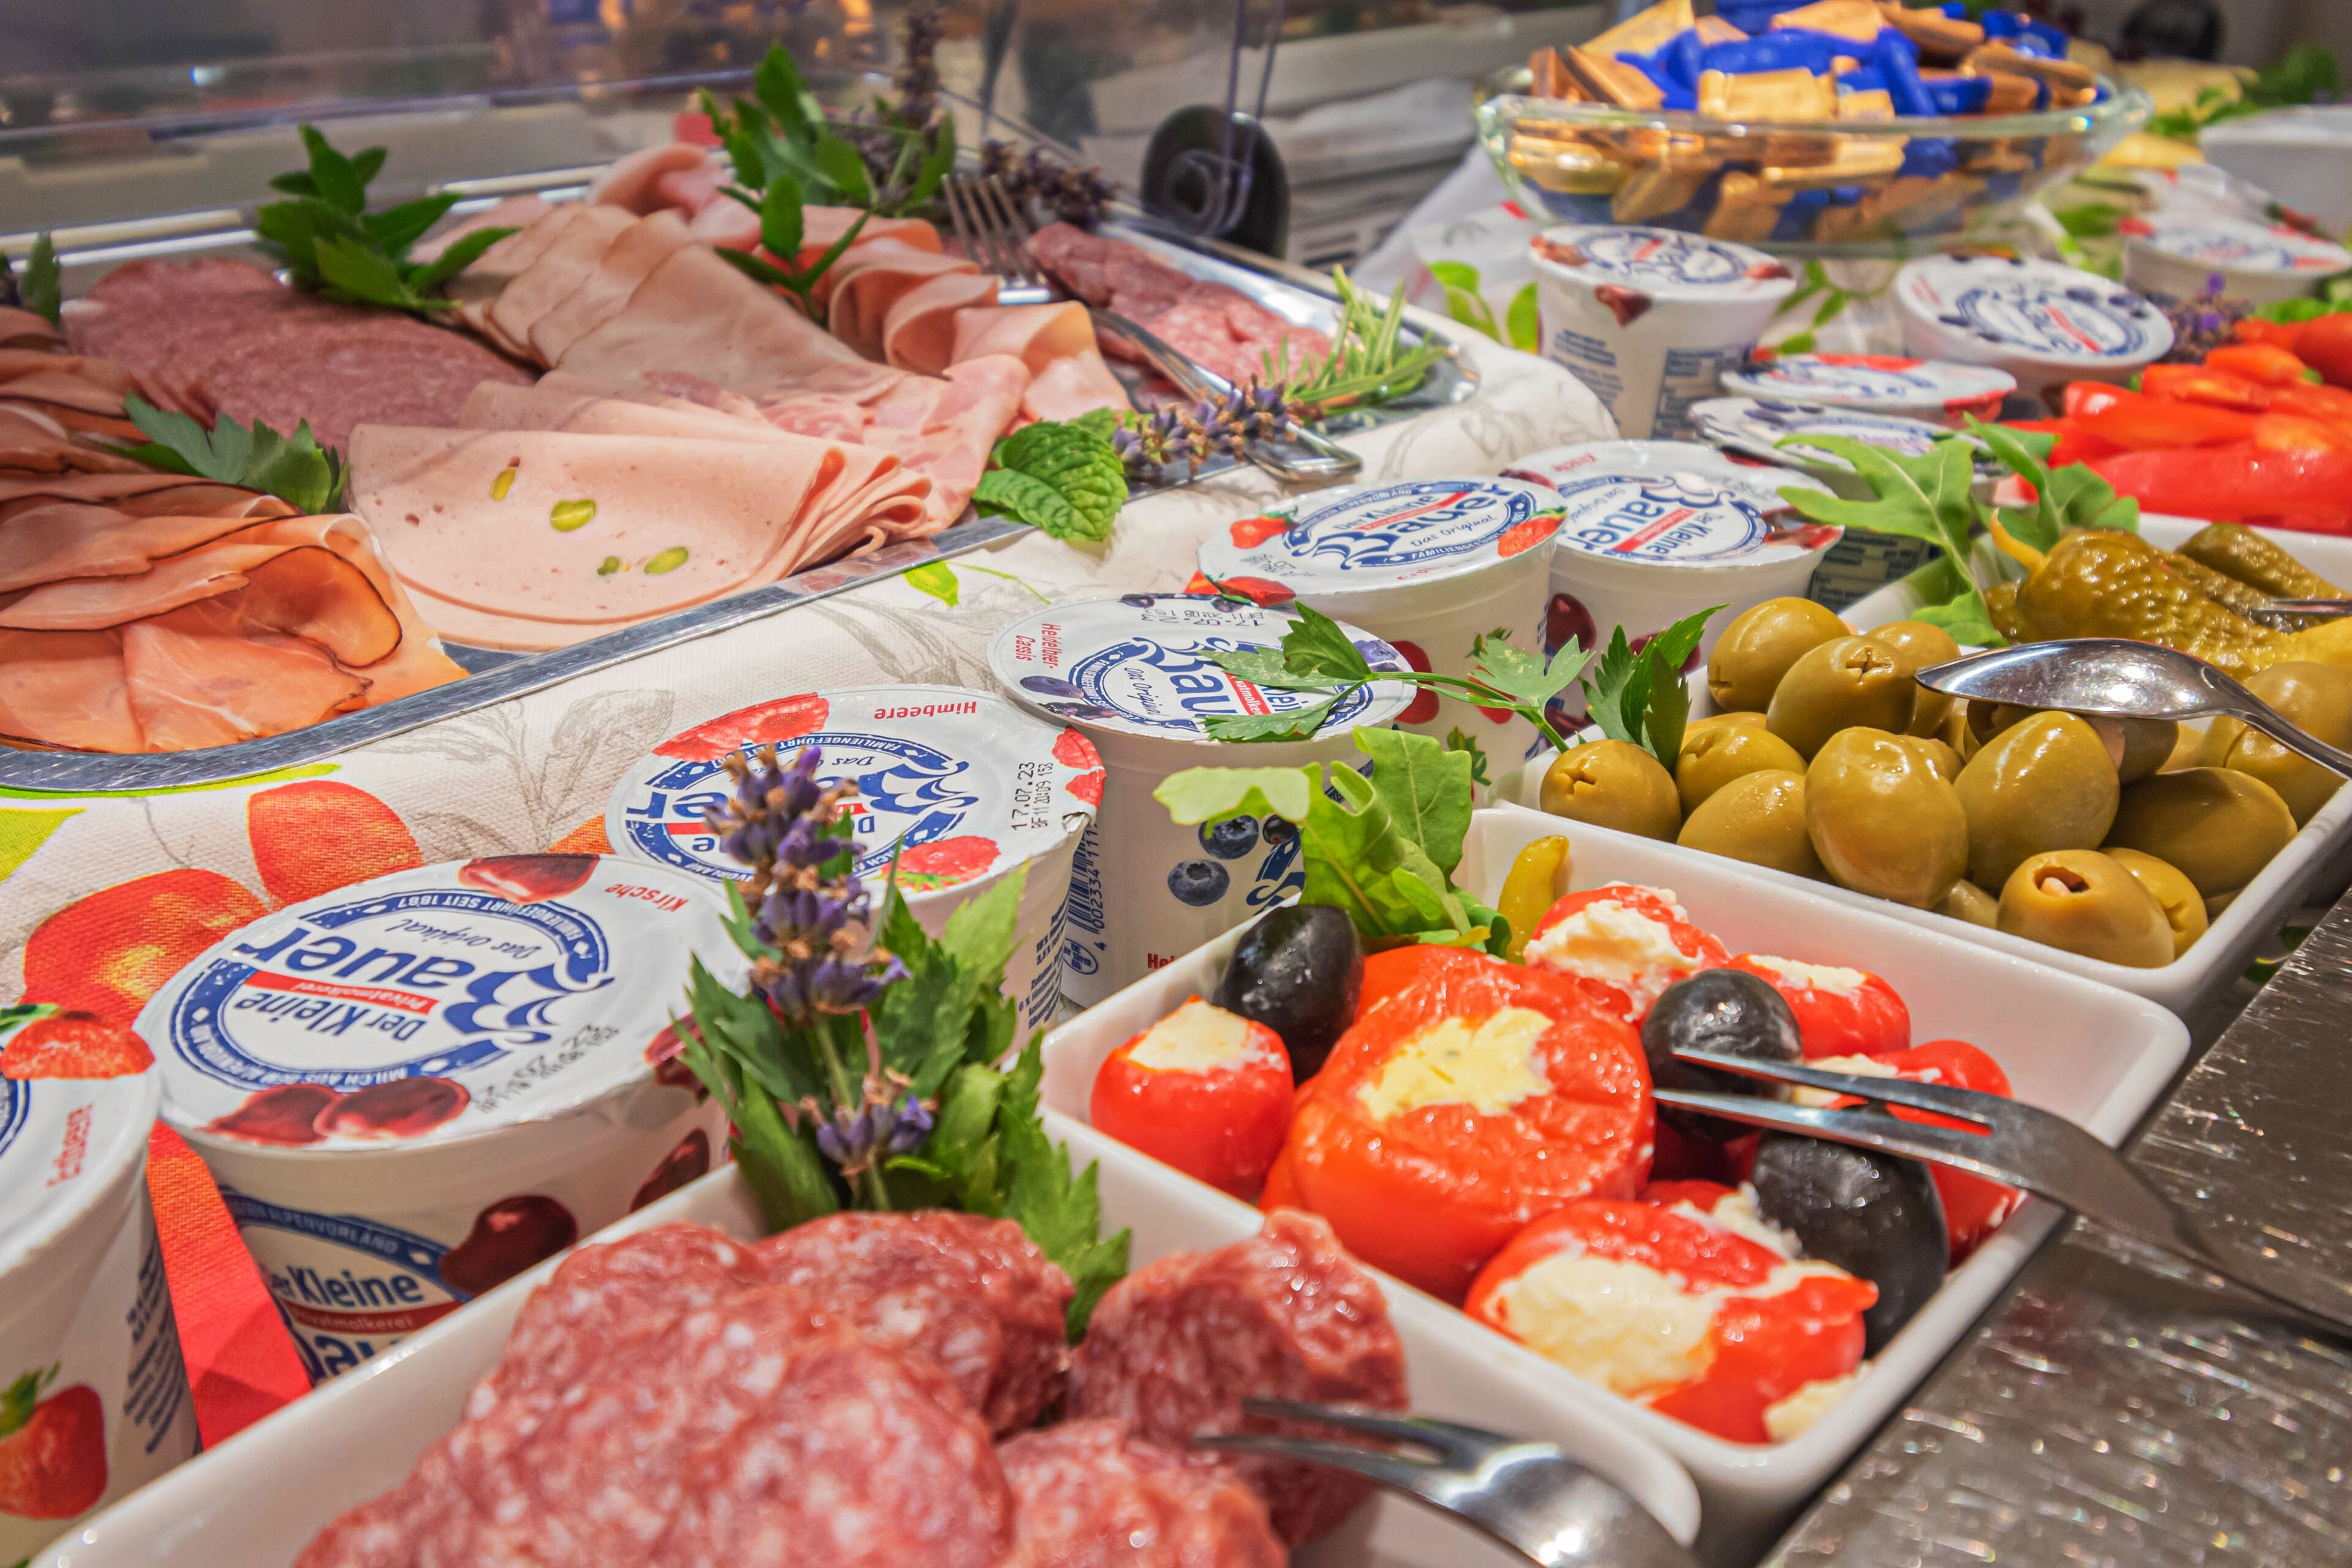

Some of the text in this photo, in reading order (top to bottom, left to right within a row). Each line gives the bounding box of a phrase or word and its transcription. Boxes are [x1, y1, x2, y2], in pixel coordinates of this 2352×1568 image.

[1645, 521, 1714, 555] Kleine
[1015, 635, 1036, 662] Cassis
[874, 701, 978, 720] Himbeere
[832, 756, 876, 767] Das
[1011, 761, 1035, 831] 17.07.23
[442, 894, 480, 910] SEIT
[605, 882, 690, 912] Kirsche
[1088, 868, 1105, 929] 002334
[385, 918, 542, 960] Das Original
[1093, 941, 1107, 951] 4
[232, 927, 615, 1042] Bauer
[235, 992, 428, 1042] Der Kleine
[287, 1264, 424, 1308] Kleine
